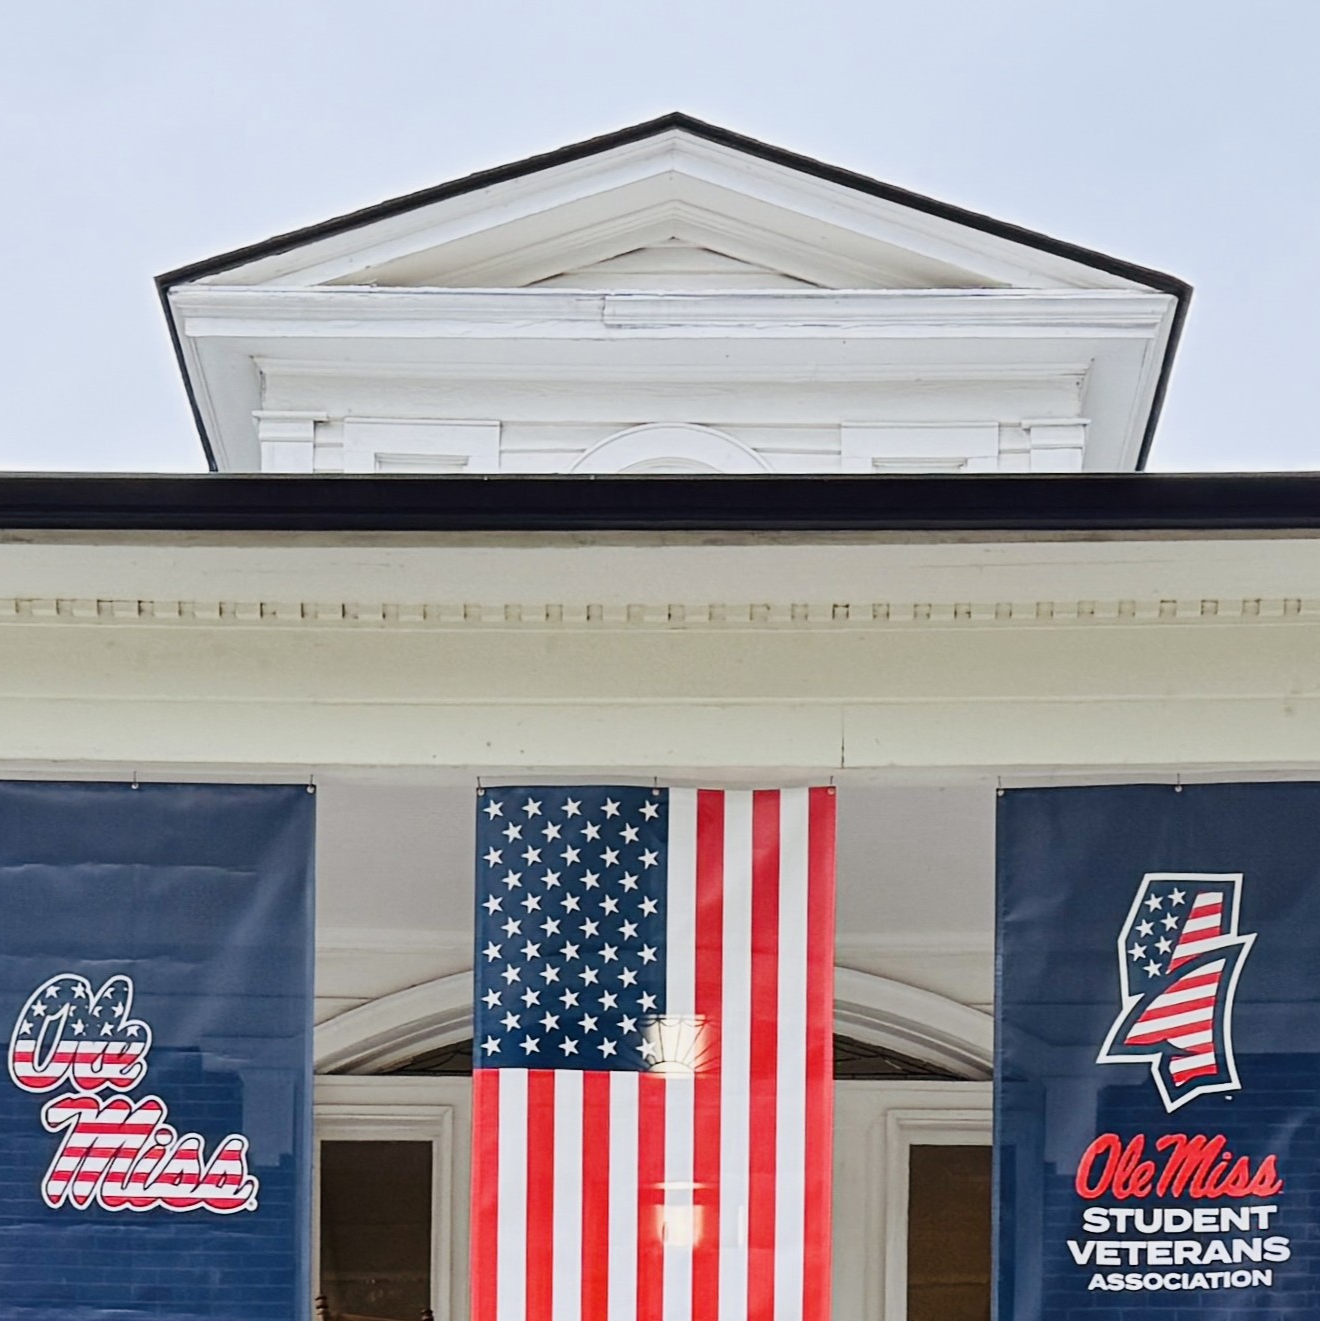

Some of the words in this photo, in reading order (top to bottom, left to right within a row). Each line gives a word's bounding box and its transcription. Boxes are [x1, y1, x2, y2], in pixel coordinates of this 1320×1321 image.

[8, 973, 152, 1094] Ole
[41, 1092, 258, 1214] Miss
[1075, 1132, 1156, 1199] Ole
[1155, 1133, 1284, 1198] Miss
[1082, 1205, 1277, 1234] STUDENT
[1066, 1236, 1291, 1266] VETERANS
[1087, 1269, 1273, 1292] ASSOCIATION
